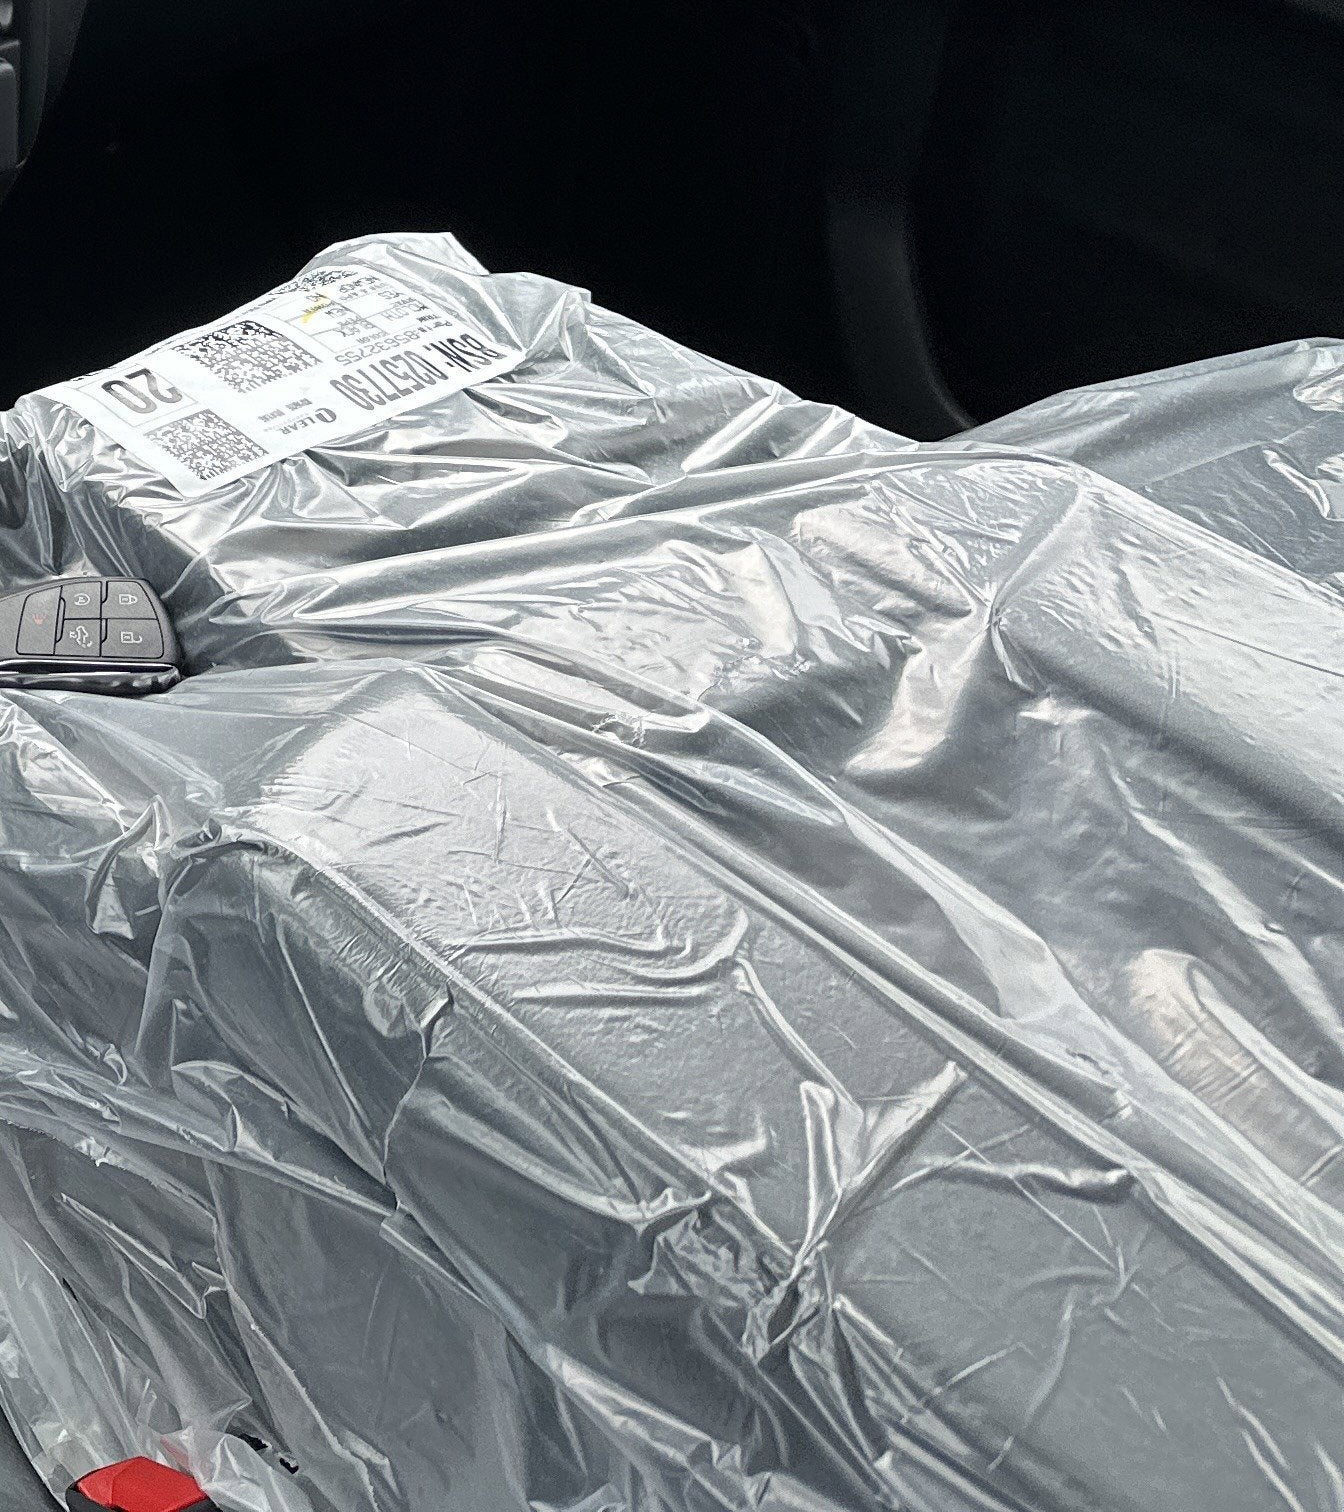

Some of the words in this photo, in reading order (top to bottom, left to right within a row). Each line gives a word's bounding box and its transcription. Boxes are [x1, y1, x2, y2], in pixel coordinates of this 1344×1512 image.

[101, 368, 183, 414] 20
[329, 350, 449, 411] 0257730
[280, 416, 316, 435] LEAR
